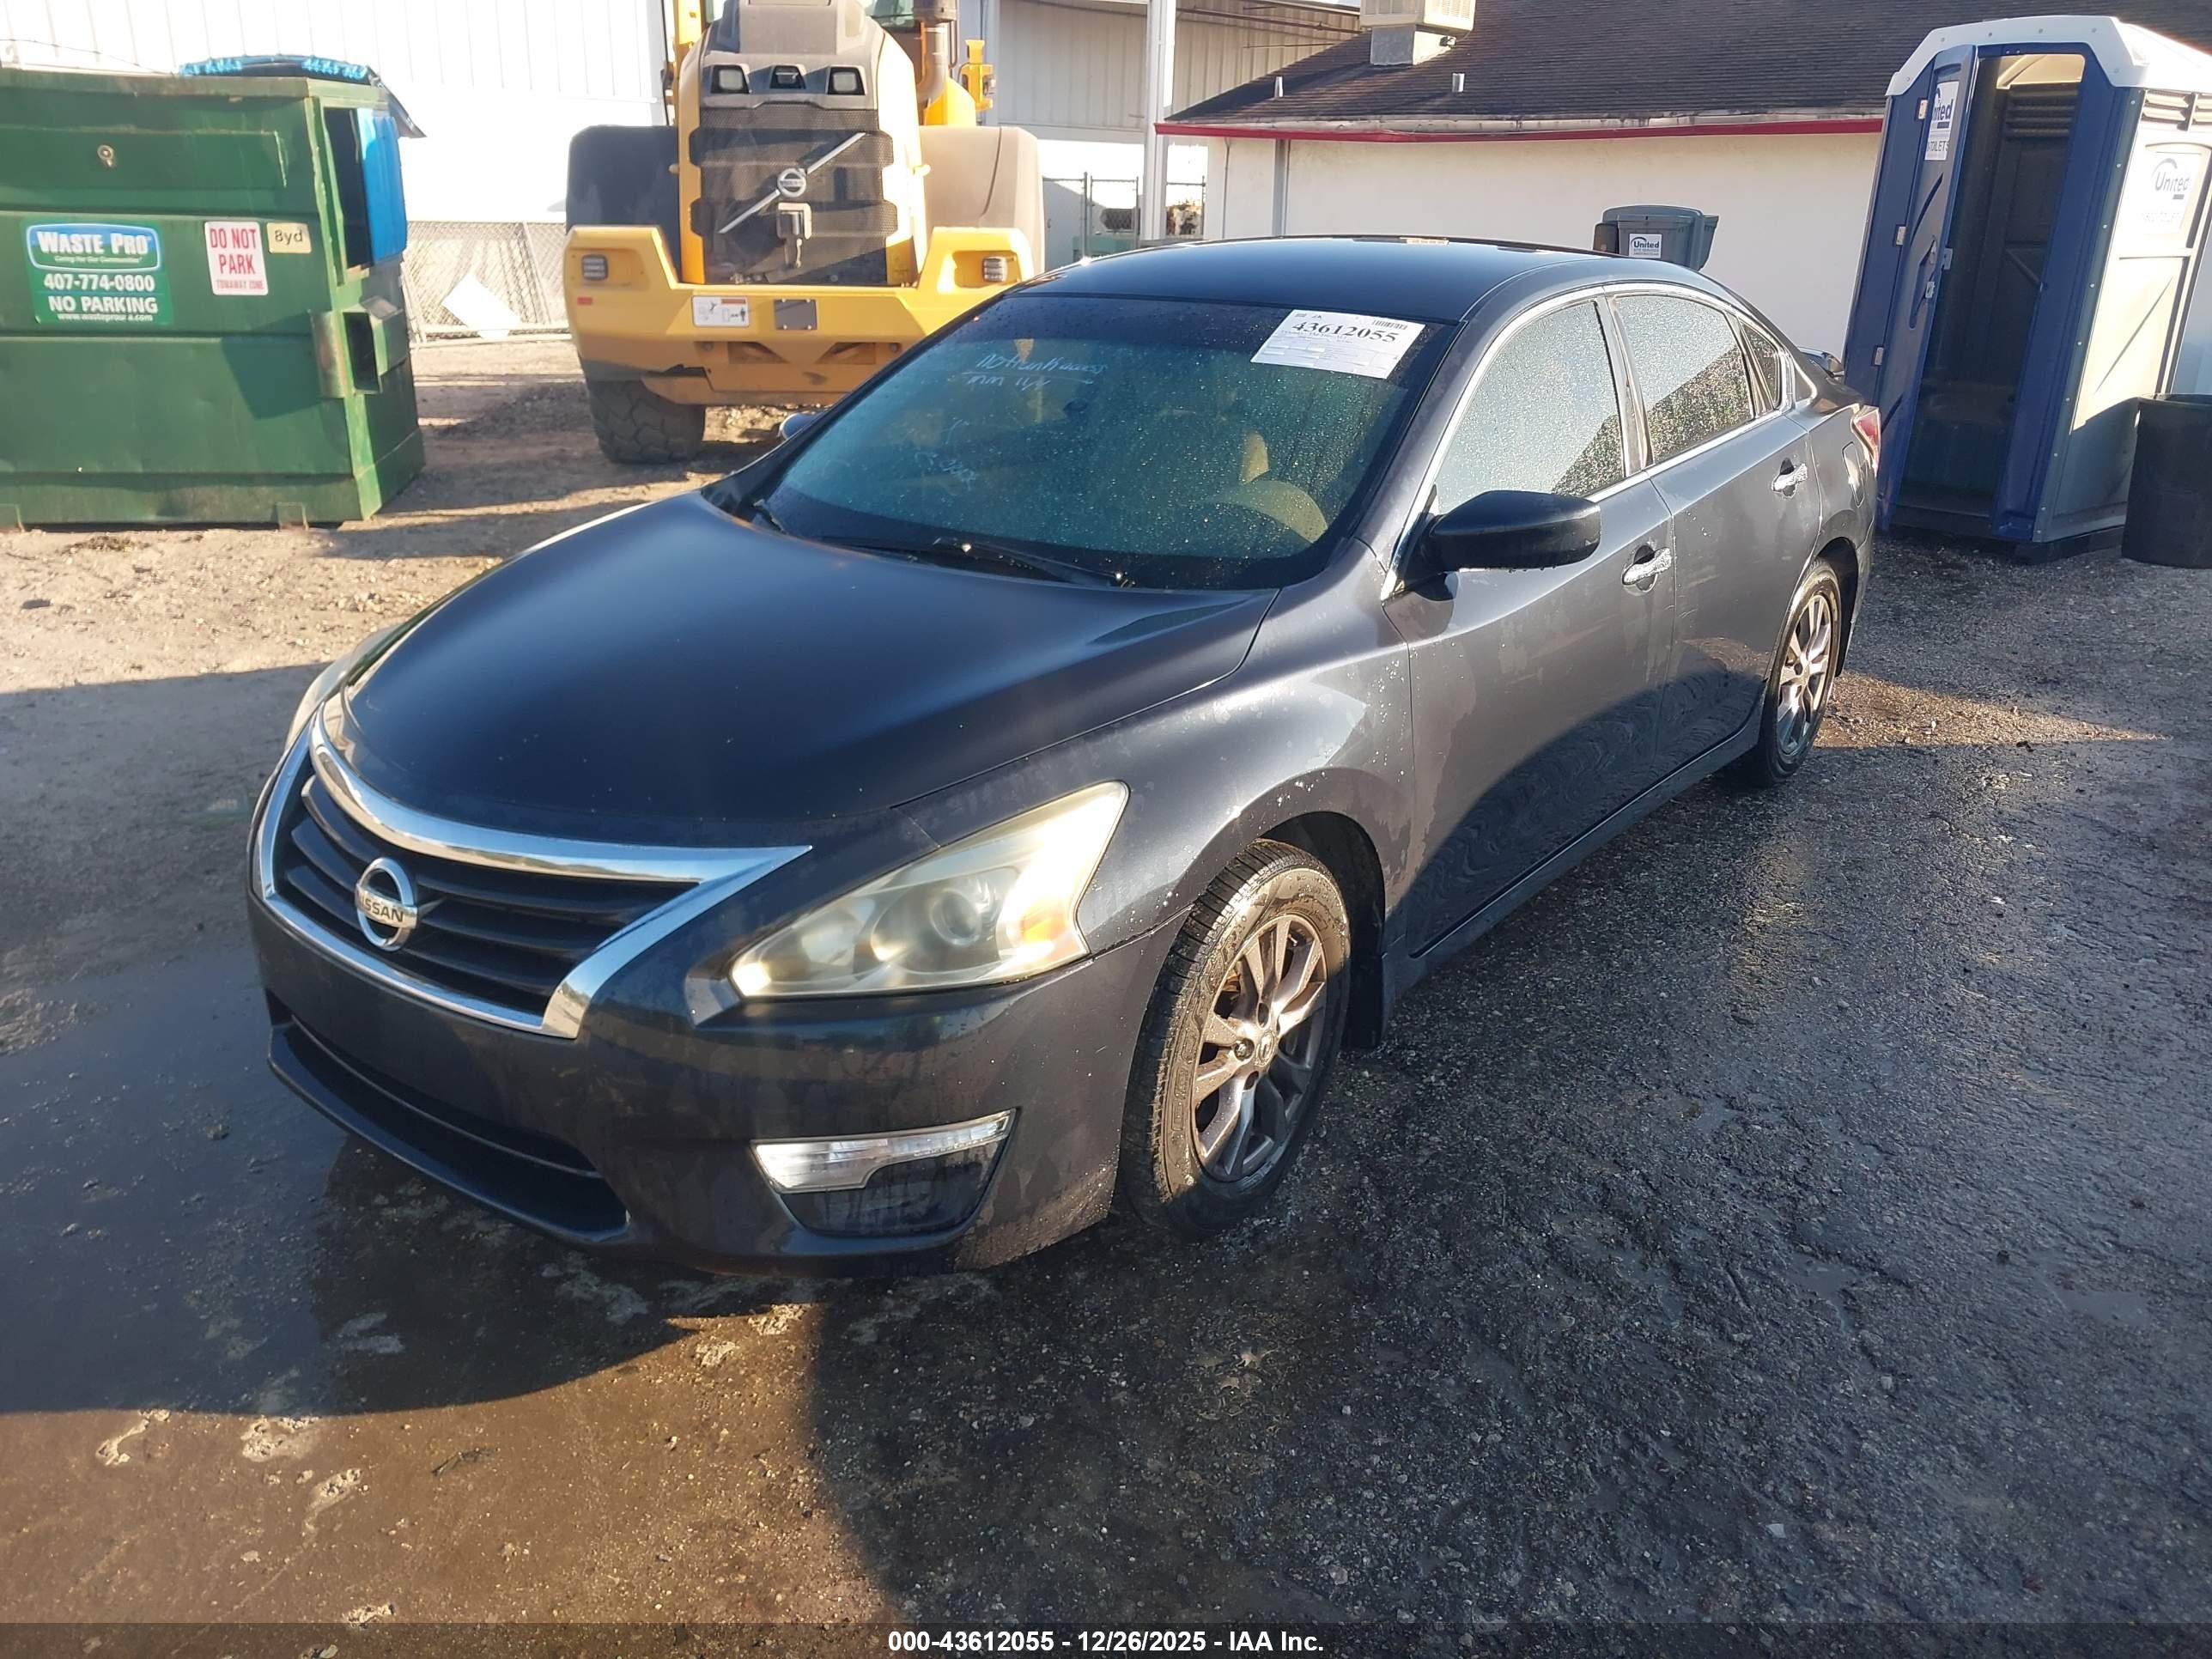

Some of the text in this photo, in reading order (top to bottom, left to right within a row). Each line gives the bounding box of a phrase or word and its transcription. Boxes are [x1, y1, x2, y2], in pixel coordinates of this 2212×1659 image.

[37, 231, 149, 255] WASTE PRO
[210, 228, 257, 249] DO NOT
[218, 254, 256, 274] PARK
[44, 273, 155, 292] 407-774-0800
[48, 295, 158, 313] NO PARKING
[1291, 321, 1401, 343] 43612055
